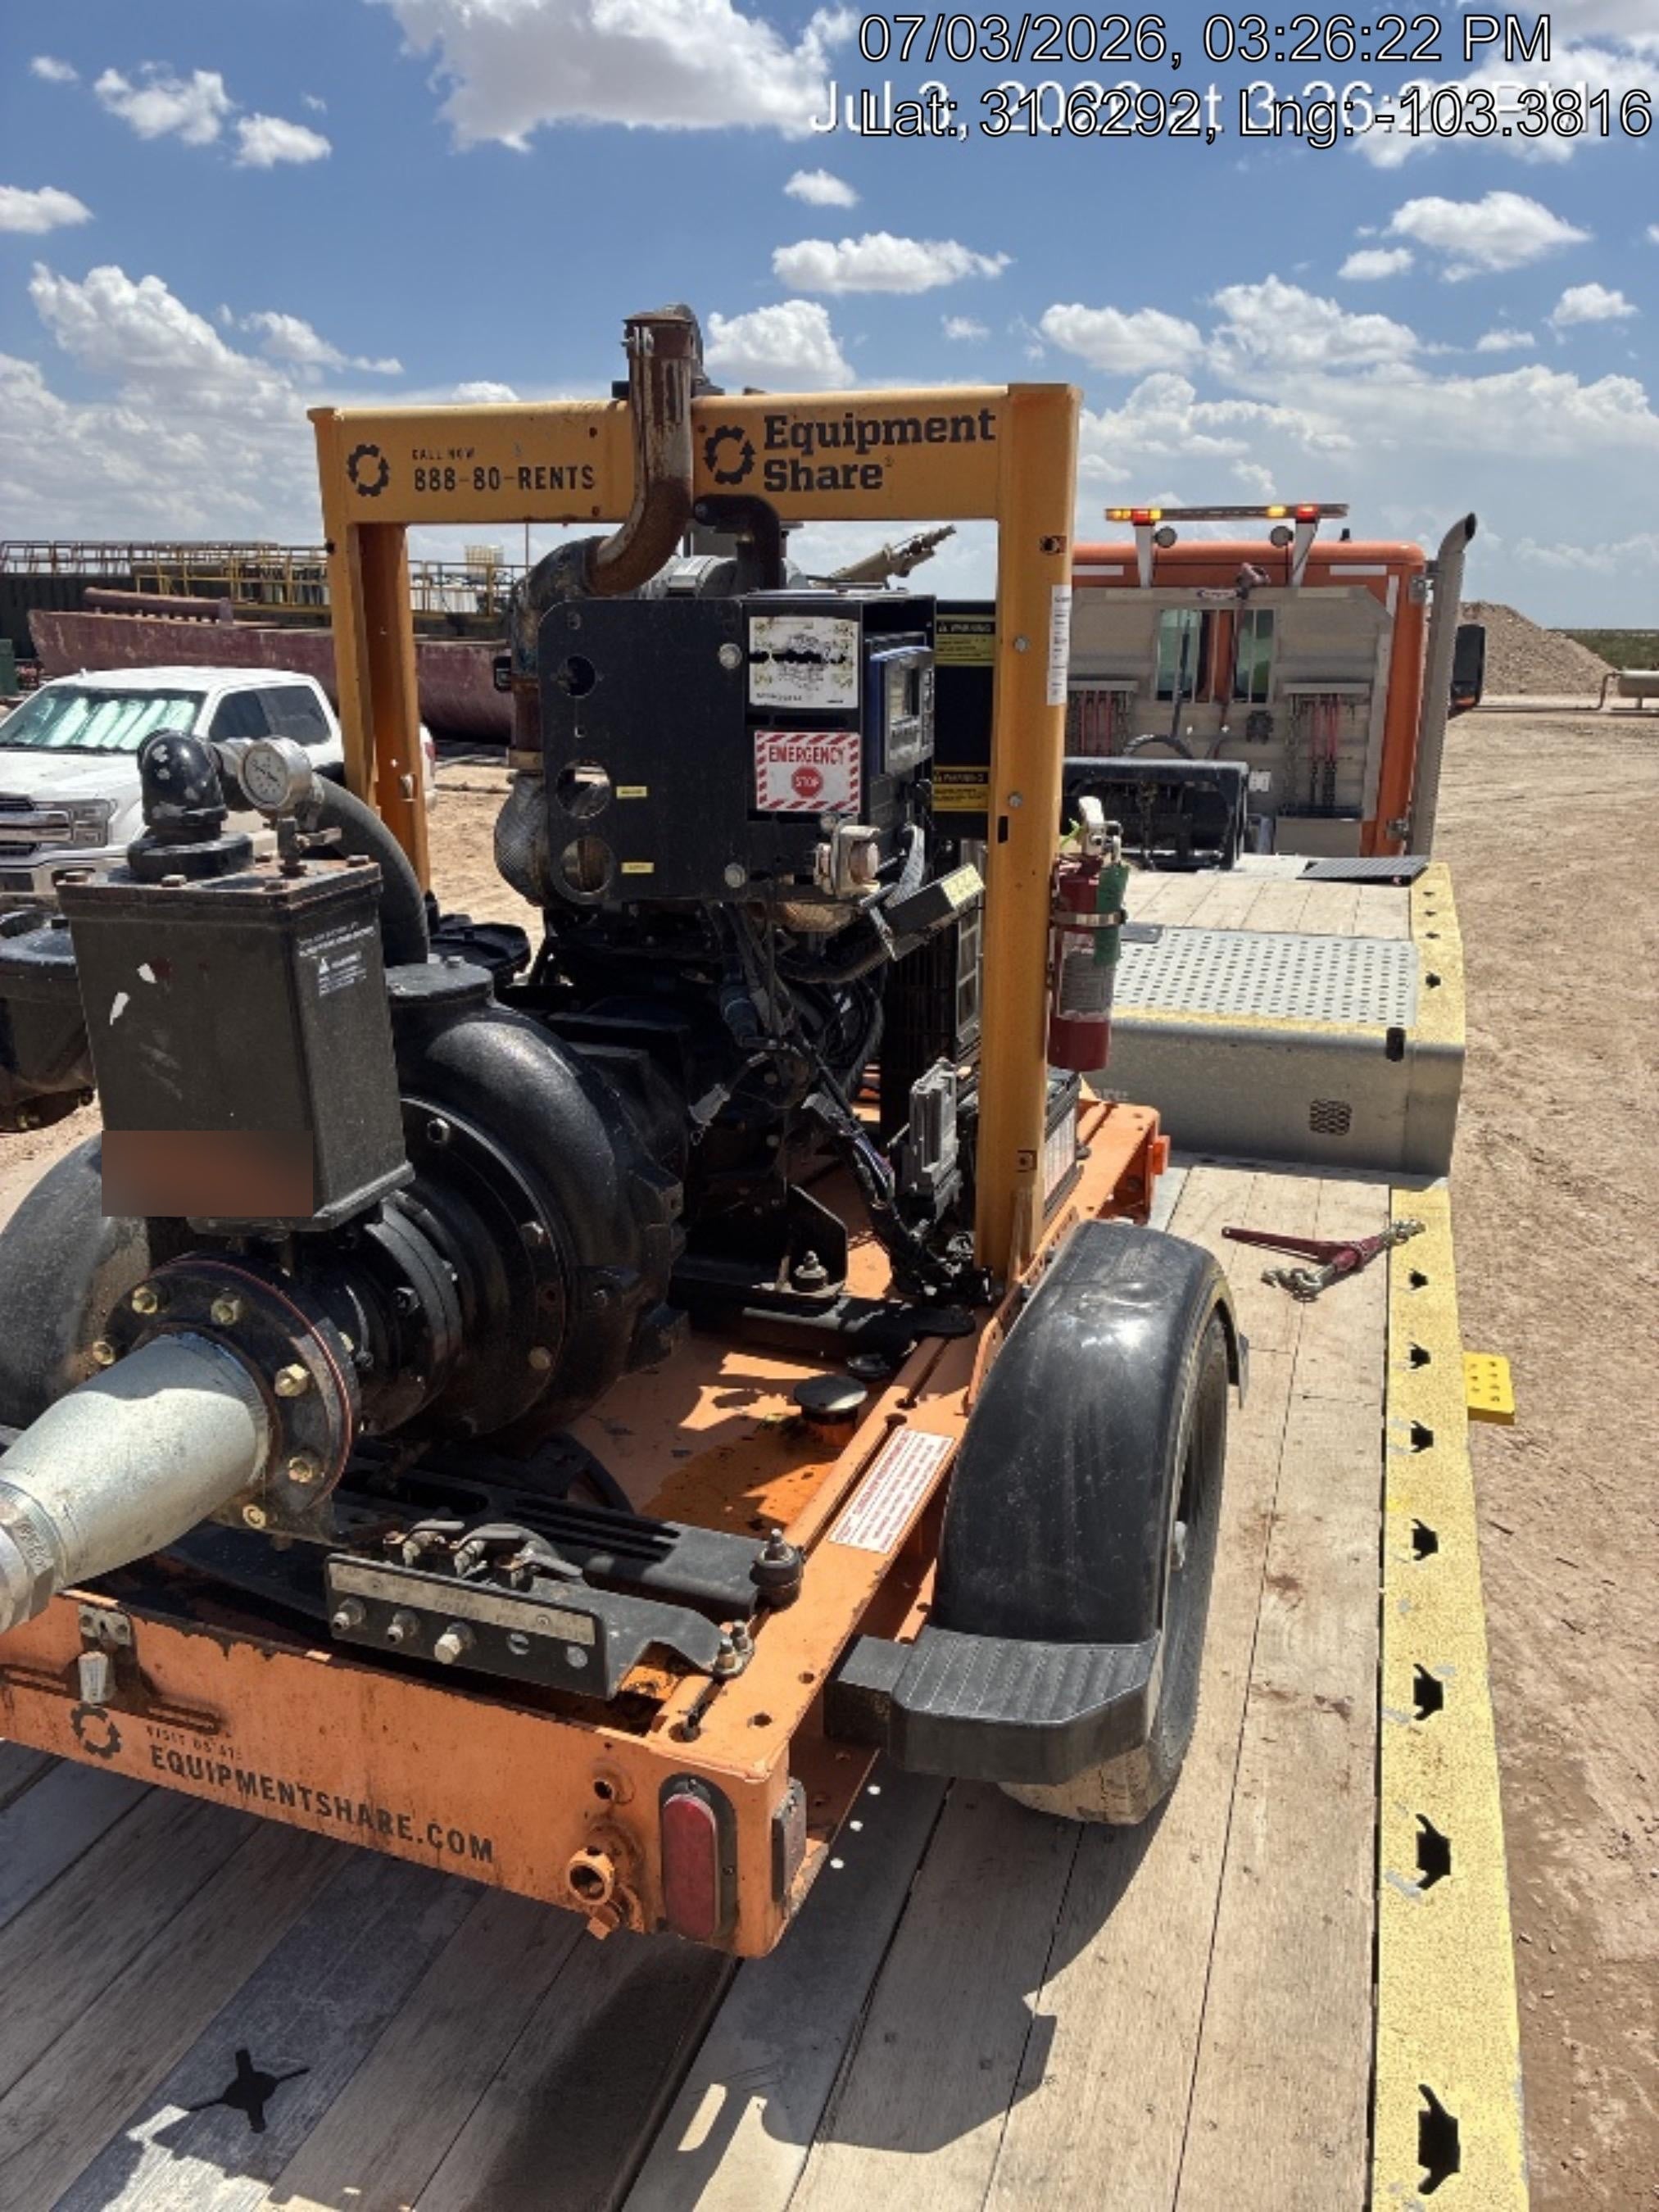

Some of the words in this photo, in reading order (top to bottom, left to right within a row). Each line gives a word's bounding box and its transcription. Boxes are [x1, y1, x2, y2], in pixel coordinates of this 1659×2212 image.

[763, 408, 996, 456] Equipment
[414, 465, 596, 492] 888-80-RENTS
[763, 458, 884, 492] Share
[768, 746, 845, 765] EMERGENCY
[795, 775, 820, 790] STOP
[149, 1743, 494, 1865] EQUIPMENTSHARE.COM
